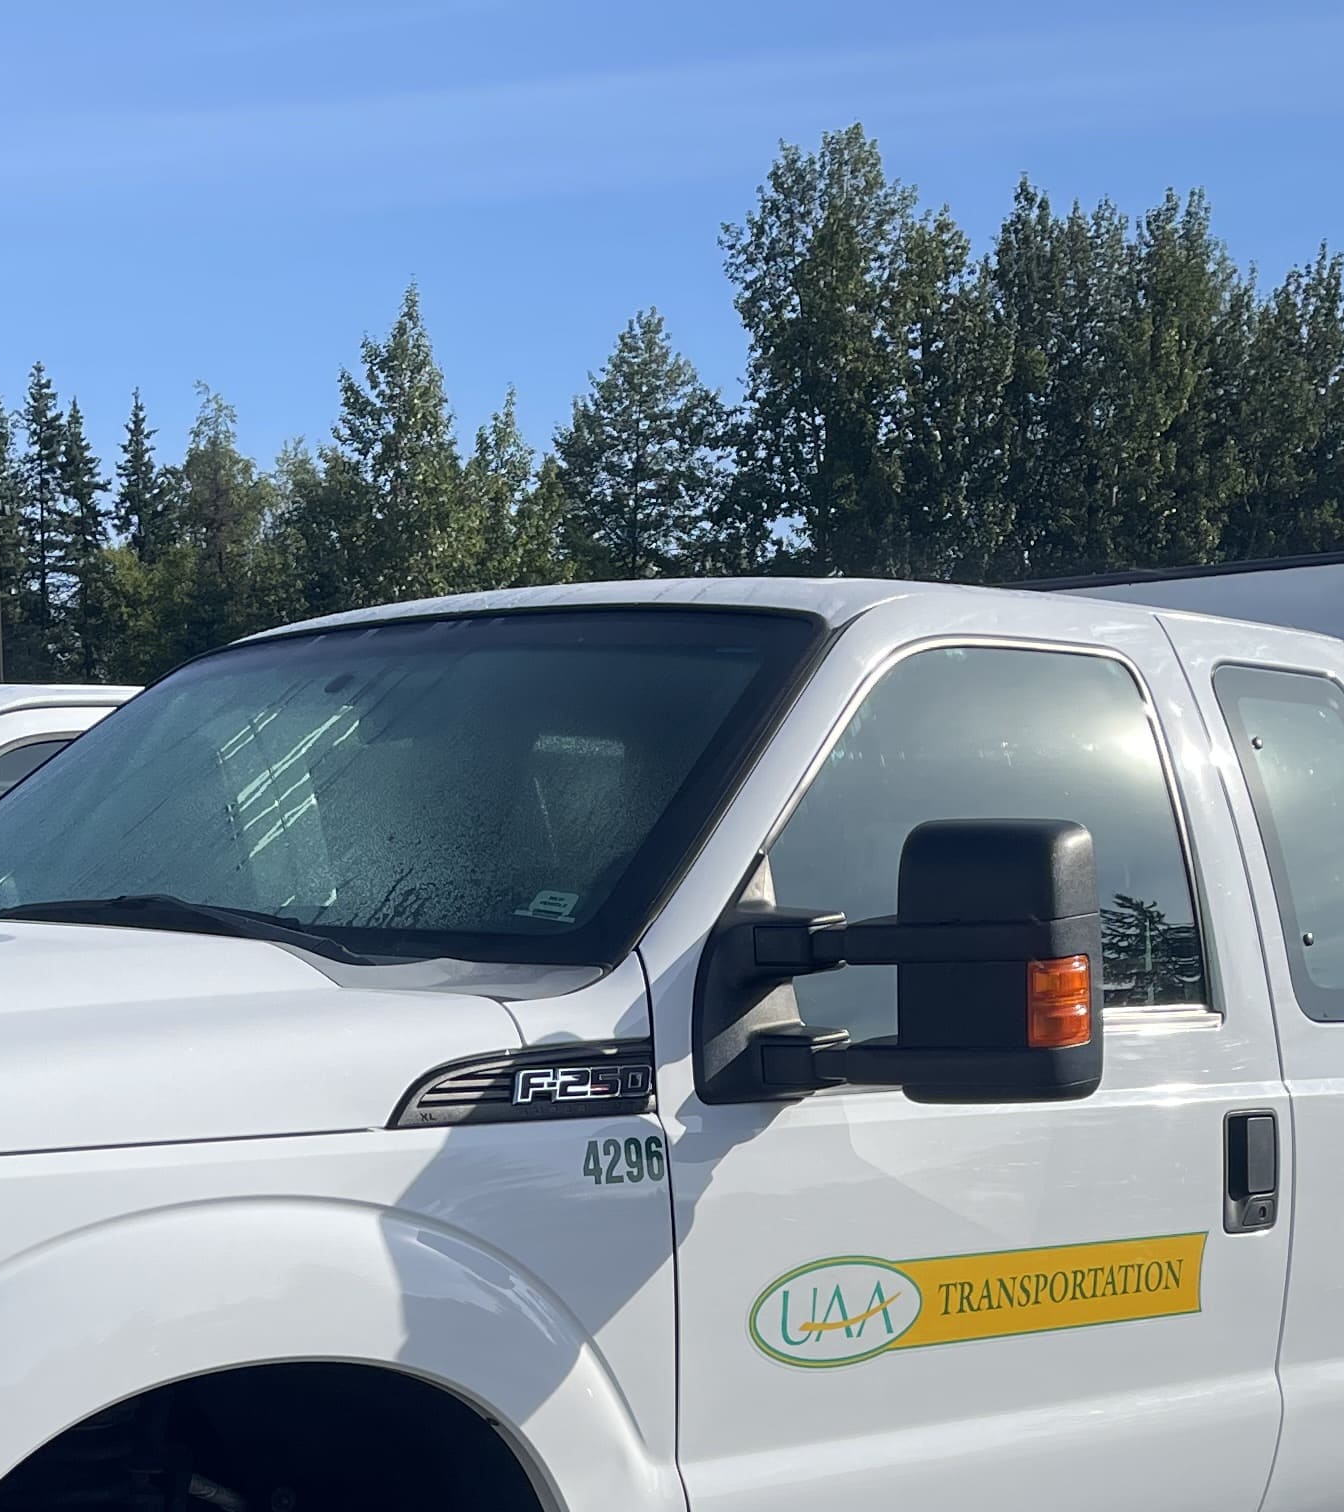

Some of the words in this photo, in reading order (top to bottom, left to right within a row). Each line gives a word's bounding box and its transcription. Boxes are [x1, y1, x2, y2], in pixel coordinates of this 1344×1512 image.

[513, 1065, 653, 1105] F-250
[420, 1113, 436, 1122] XL
[583, 1136, 665, 1184] 4296
[780, 1280, 896, 1346] UAA
[938, 1258, 1184, 1316] TRANSPORTATION
